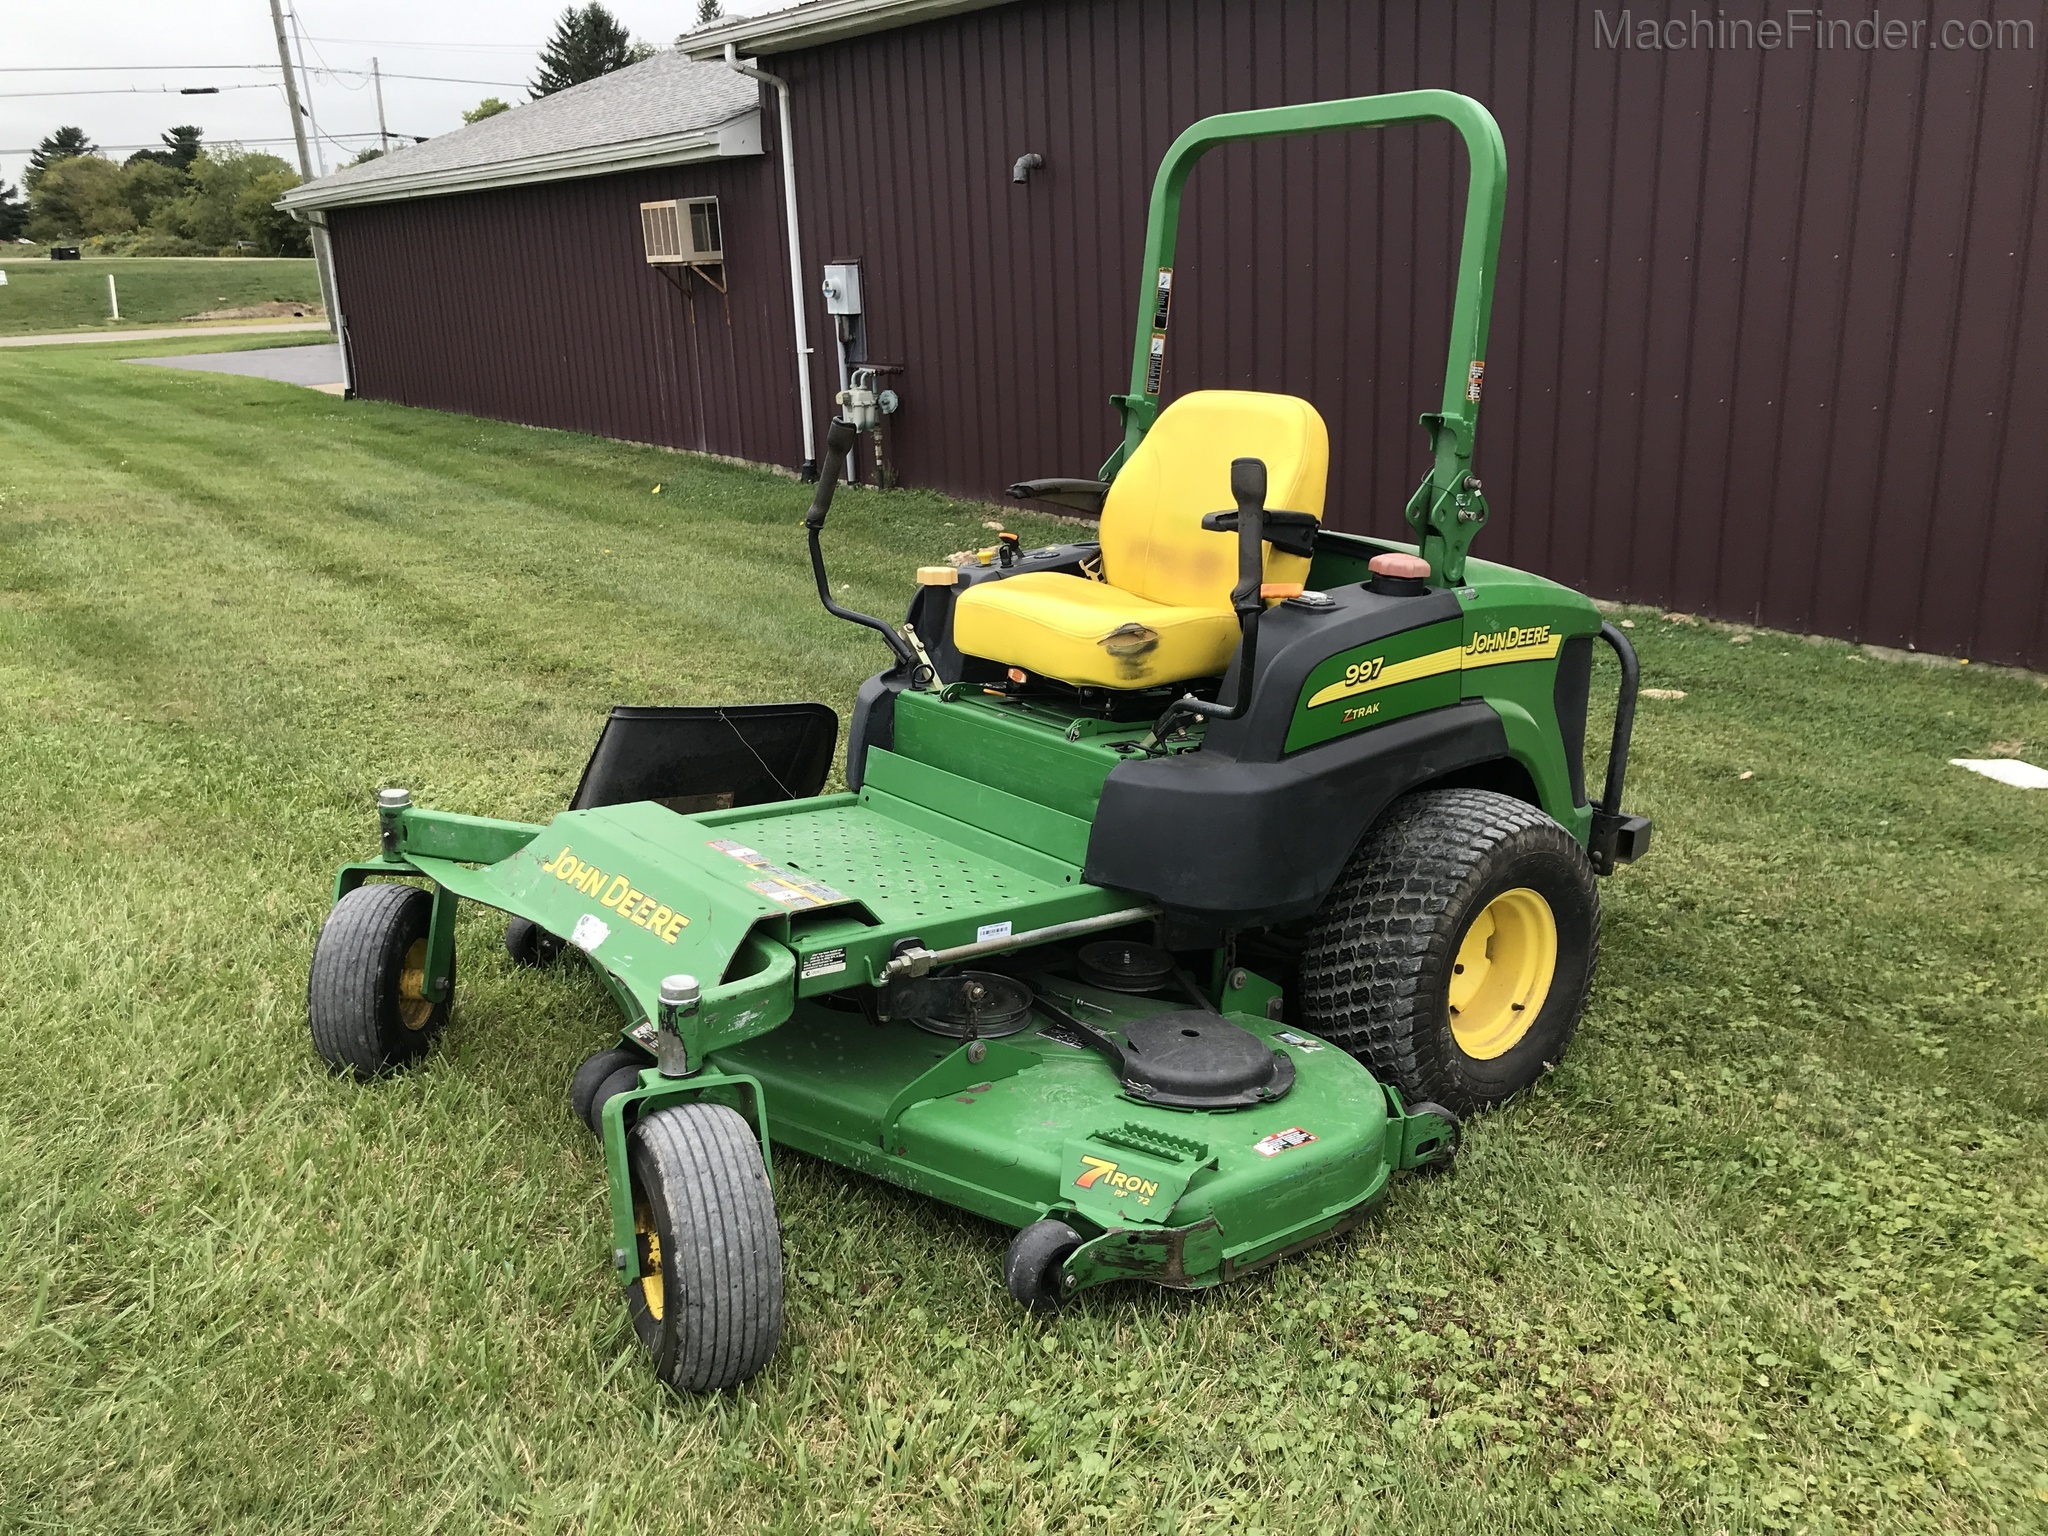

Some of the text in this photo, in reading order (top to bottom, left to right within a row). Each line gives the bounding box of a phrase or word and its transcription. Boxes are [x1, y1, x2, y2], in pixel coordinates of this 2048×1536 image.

[1344, 656, 1385, 687] 997
[543, 845, 610, 898] JOHN
[599, 873, 691, 945] DEERE
[1137, 1195, 1151, 1206] 72
